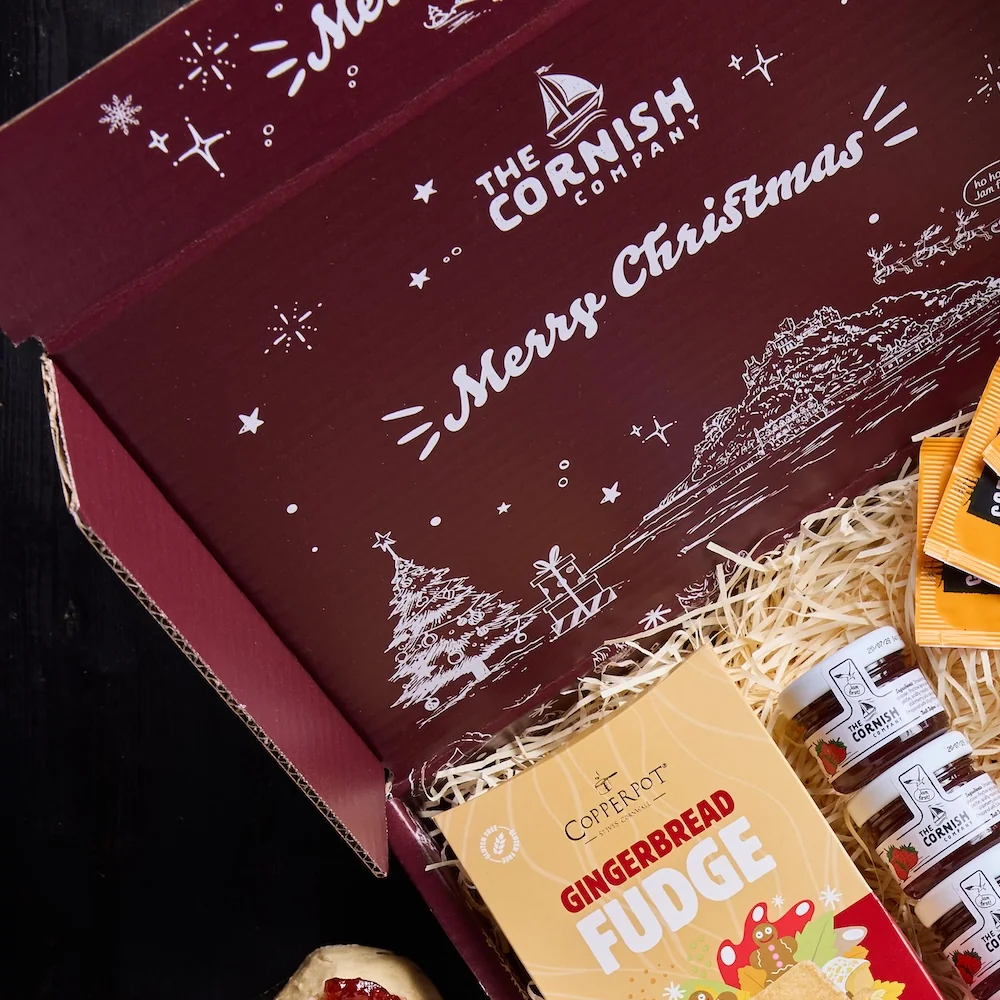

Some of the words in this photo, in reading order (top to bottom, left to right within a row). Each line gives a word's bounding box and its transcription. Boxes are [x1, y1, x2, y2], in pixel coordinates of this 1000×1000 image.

[475, 144, 541, 196] THE
[489, 77, 695, 232] CORNISH
[574, 113, 700, 206] COMPANY
[973, 178, 987, 190] ho
[974, 185, 995, 201] Jam
[443, 292, 606, 432] Merry
[612, 130, 863, 298] Christmas
[848, 720, 863, 732] THE
[852, 707, 900, 742] CORNISH
[873, 717, 903, 738] COMPANY
[919, 824, 934, 837] THE
[923, 810, 970, 847] CORNISH
[944, 821, 973, 842] COMPANY
[560, 789, 735, 913] GINGERBREAD
[575, 815, 777, 975] FUDGE
[981, 930, 996, 943] THE
